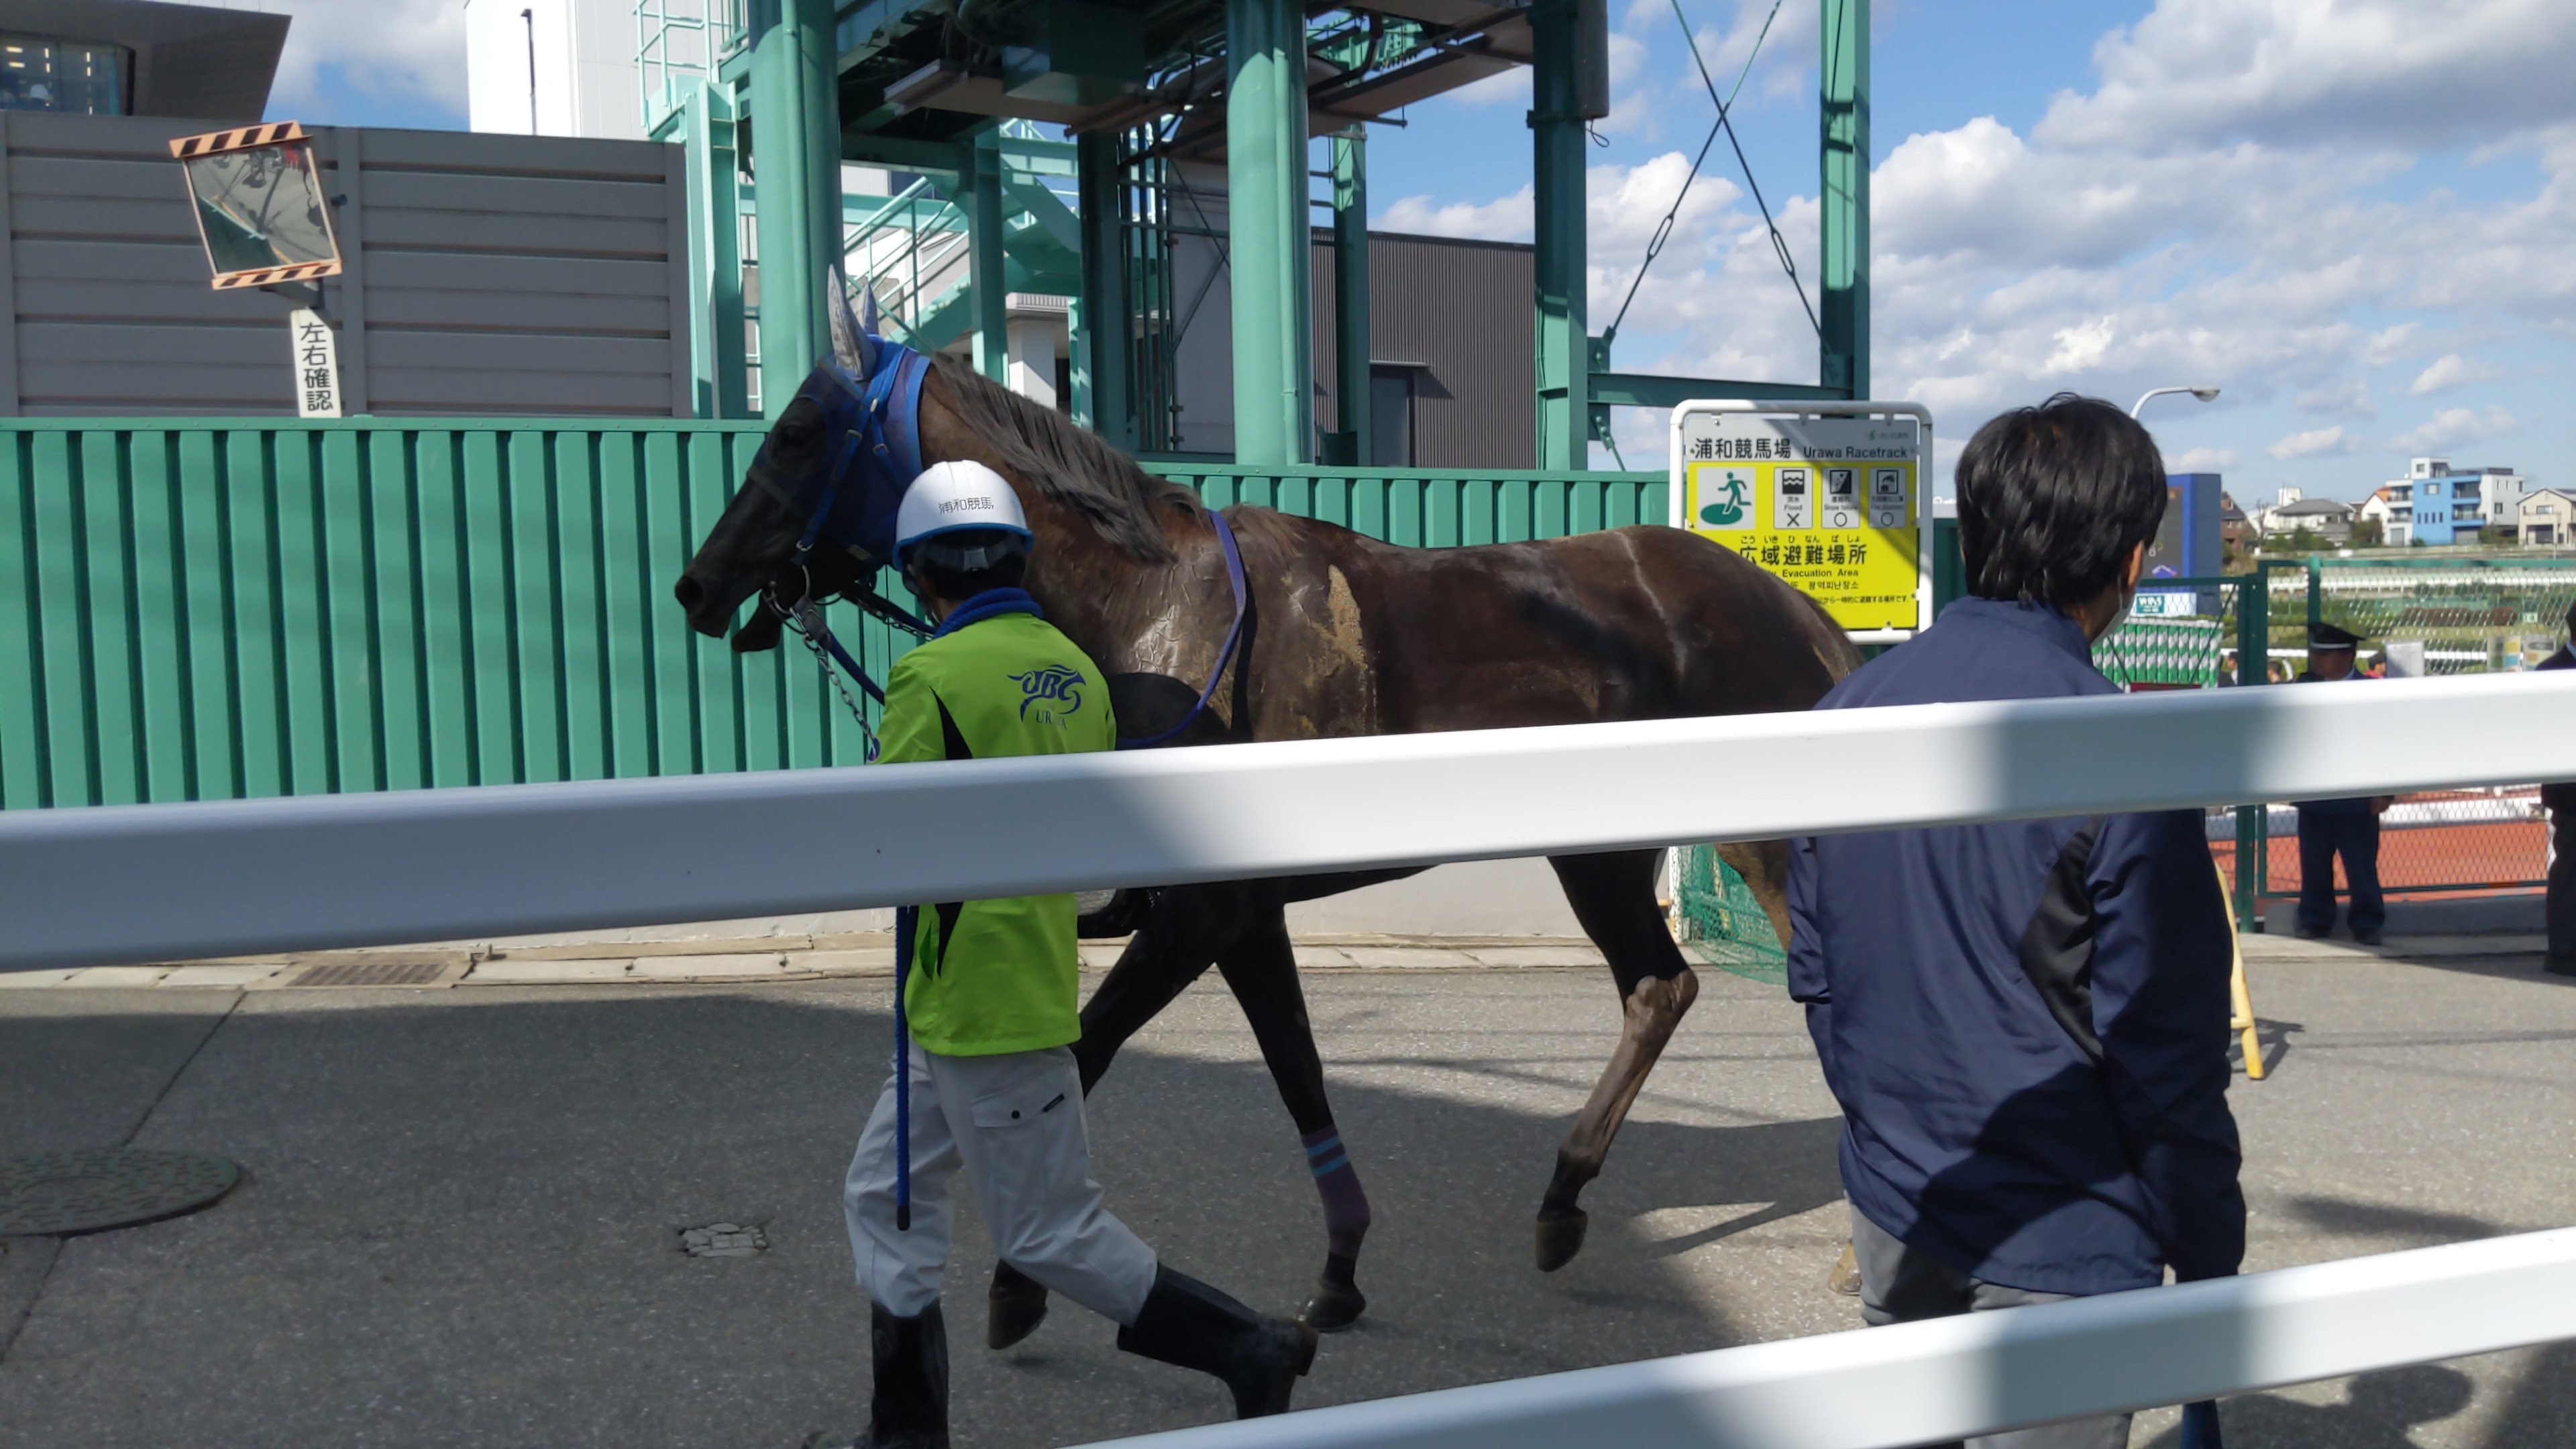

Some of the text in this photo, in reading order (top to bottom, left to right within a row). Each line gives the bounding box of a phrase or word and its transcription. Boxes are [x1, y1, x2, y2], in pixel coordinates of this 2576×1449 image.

[299, 322, 333, 412] 左右確認
[1695, 438, 1791, 459] 浦和競馬場
[1803, 446, 1908, 458] Urawa Racetrack
[938, 496, 994, 515] 浦和競馬
[1741, 535, 1756, 544] こう
[1764, 535, 1778, 544] いき
[1788, 535, 1795, 543] ひ
[1805, 535, 1820, 543] なん
[1739, 544, 1867, 566] 広域避難場所
[1782, 569, 1832, 578] Evacuation
[1837, 569, 1859, 577] Area
[1036, 708, 1067, 730] URA
